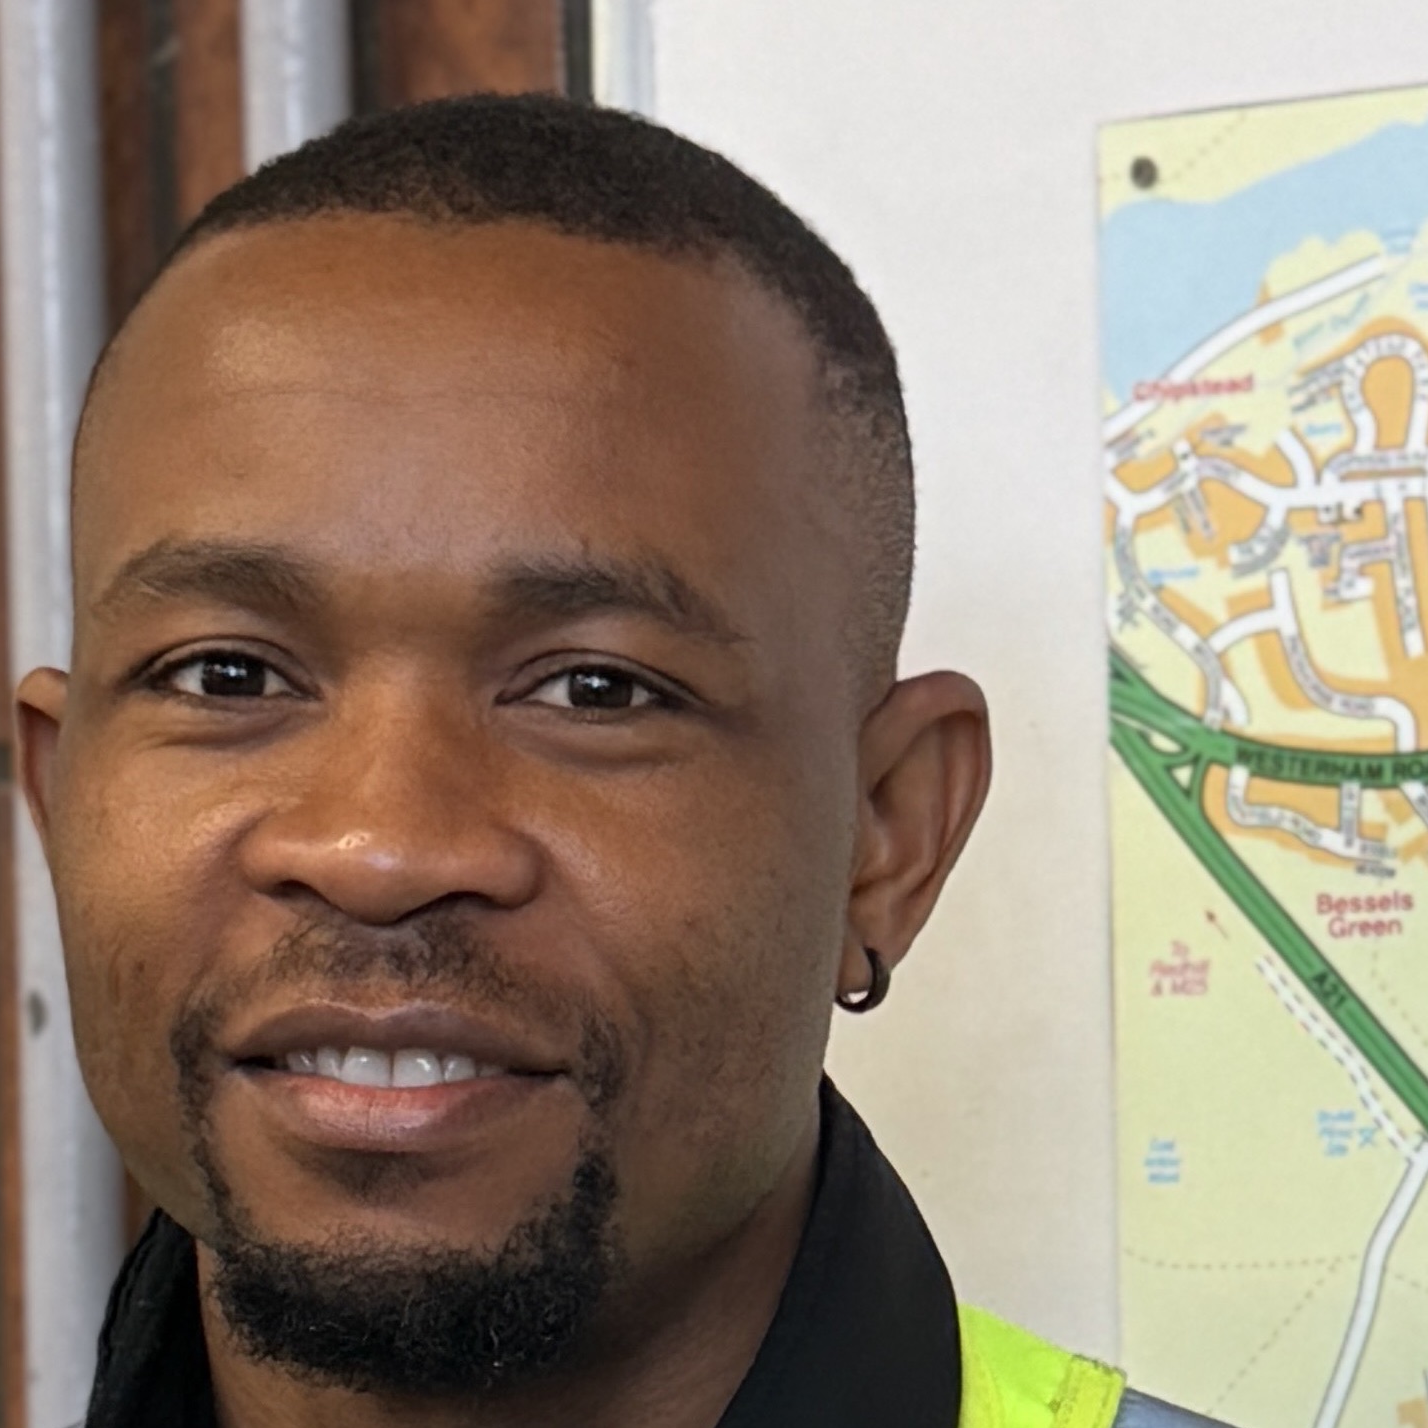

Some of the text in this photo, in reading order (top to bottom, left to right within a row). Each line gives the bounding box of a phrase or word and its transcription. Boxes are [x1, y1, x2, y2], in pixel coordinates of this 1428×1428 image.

[1234, 745, 1384, 781] WESTERHAM
[1315, 893, 1415, 916] Bessels
[1327, 916, 1403, 939] Green
[1310, 971, 1347, 1010] A21
